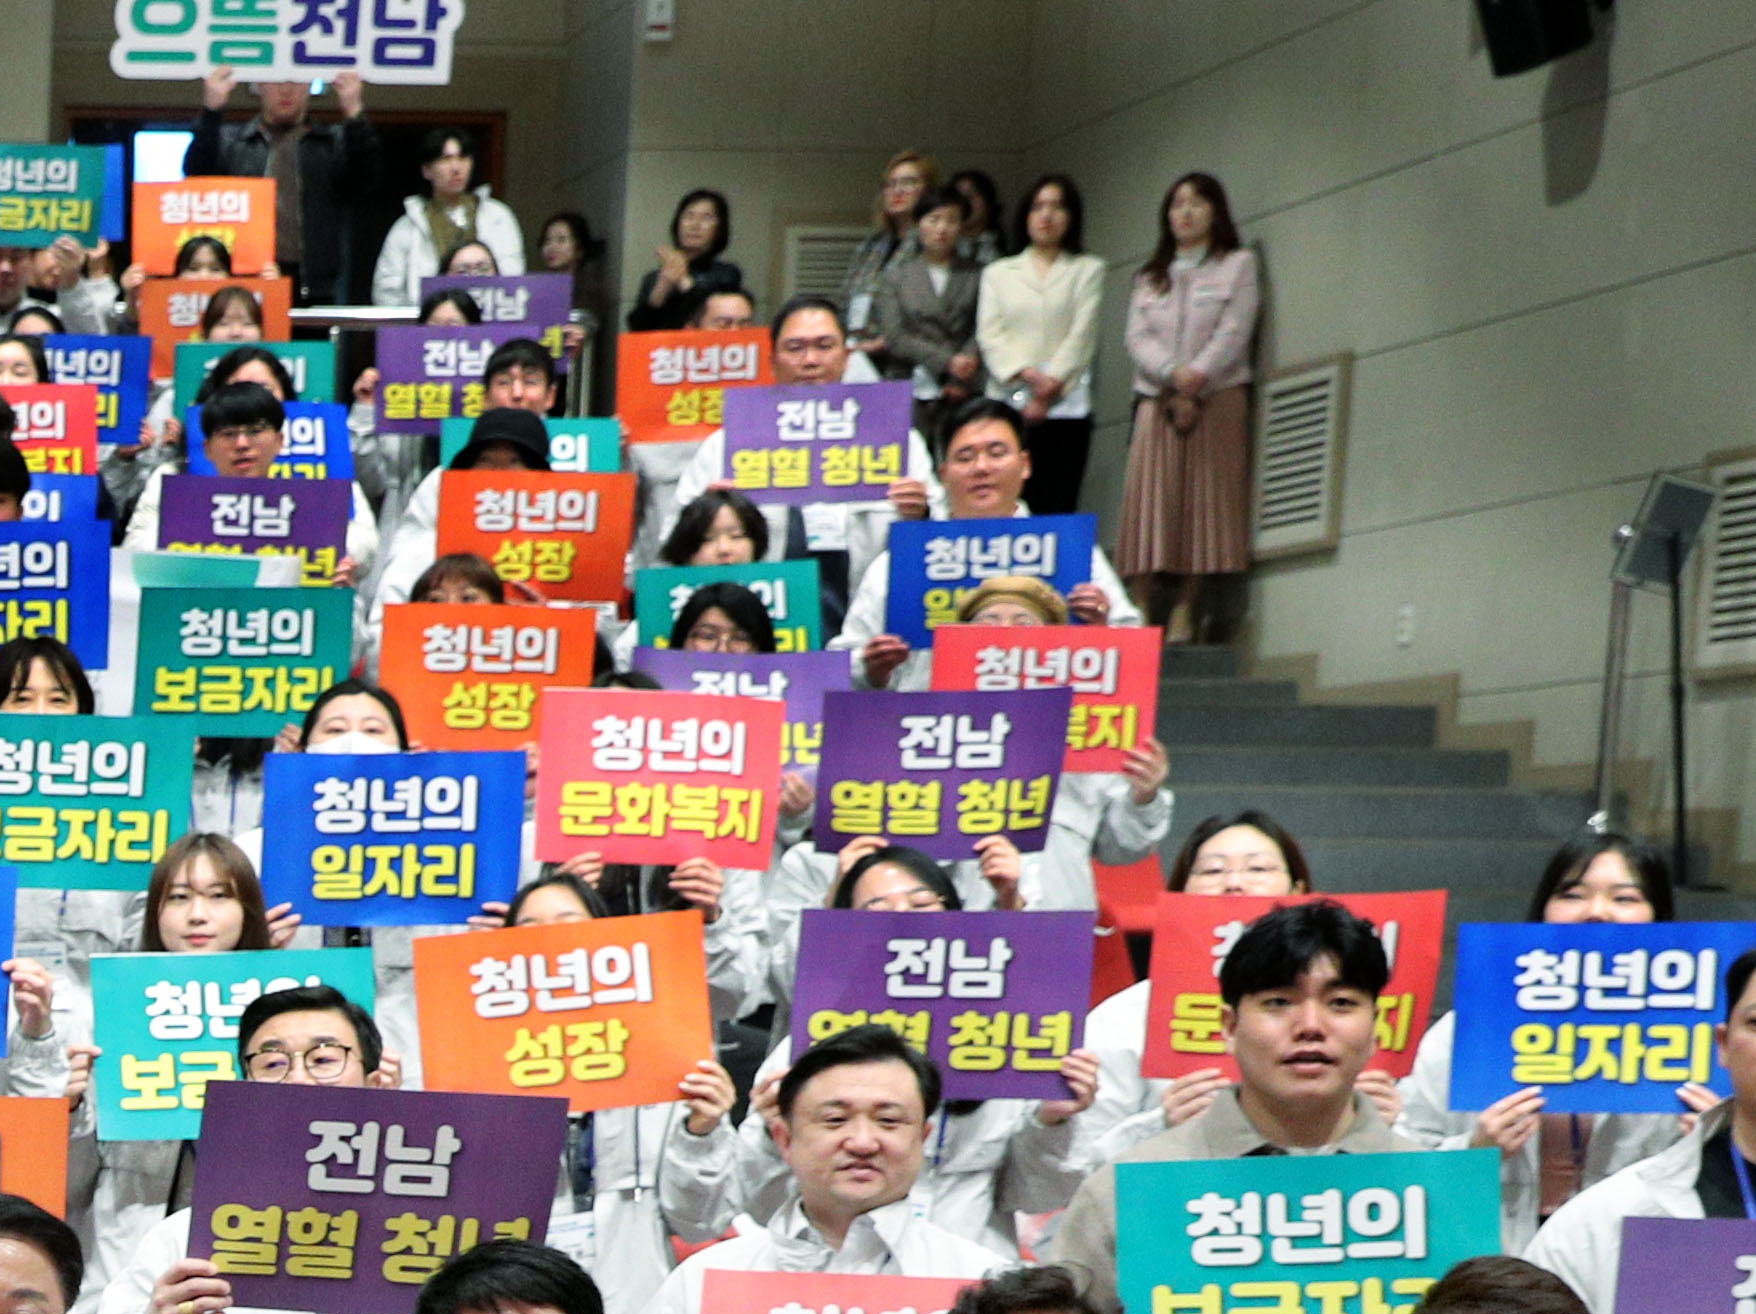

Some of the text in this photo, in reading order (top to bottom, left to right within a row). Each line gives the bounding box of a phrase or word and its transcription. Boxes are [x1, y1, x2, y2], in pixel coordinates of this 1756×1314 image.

[159, 190, 250, 223] 청년의
[423, 339, 490, 376] 전남
[648, 341, 759, 380] 청년의
[383, 382, 453, 419] 열혈
[775, 398, 859, 441] 전남
[730, 443, 901, 489] 열혈 청년
[210, 495, 296, 538] 전남
[473, 489, 599, 533] 청년의
[492, 539, 577, 582] 성장
[923, 532, 1058, 580] 청년의
[179, 606, 316, 657] 청년의
[421, 622, 559, 676] 청년의
[150, 665, 336, 715] 보금자리
[974, 645, 1120, 696] 청년의
[442, 681, 537, 731] 성장
[591, 714, 748, 776] 청년의
[898, 710, 1012, 772] 전남
[311, 773, 481, 836] 청년의
[558, 779, 764, 844] 문화복지
[829, 773, 1053, 837] 열혈 청년
[310, 842, 476, 902] 일자리
[468, 941, 655, 1021] 청년의
[883, 937, 1016, 1000] 전남
[1511, 947, 1719, 1013] 청년의
[503, 1016, 631, 1090] 성장
[947, 1009, 1074, 1073] 청년
[1509, 1022, 1713, 1086] 일자리
[303, 1118, 464, 1200] 전남
[209, 1201, 362, 1283] 열혈
[1185, 1184, 1429, 1267] 청년의
